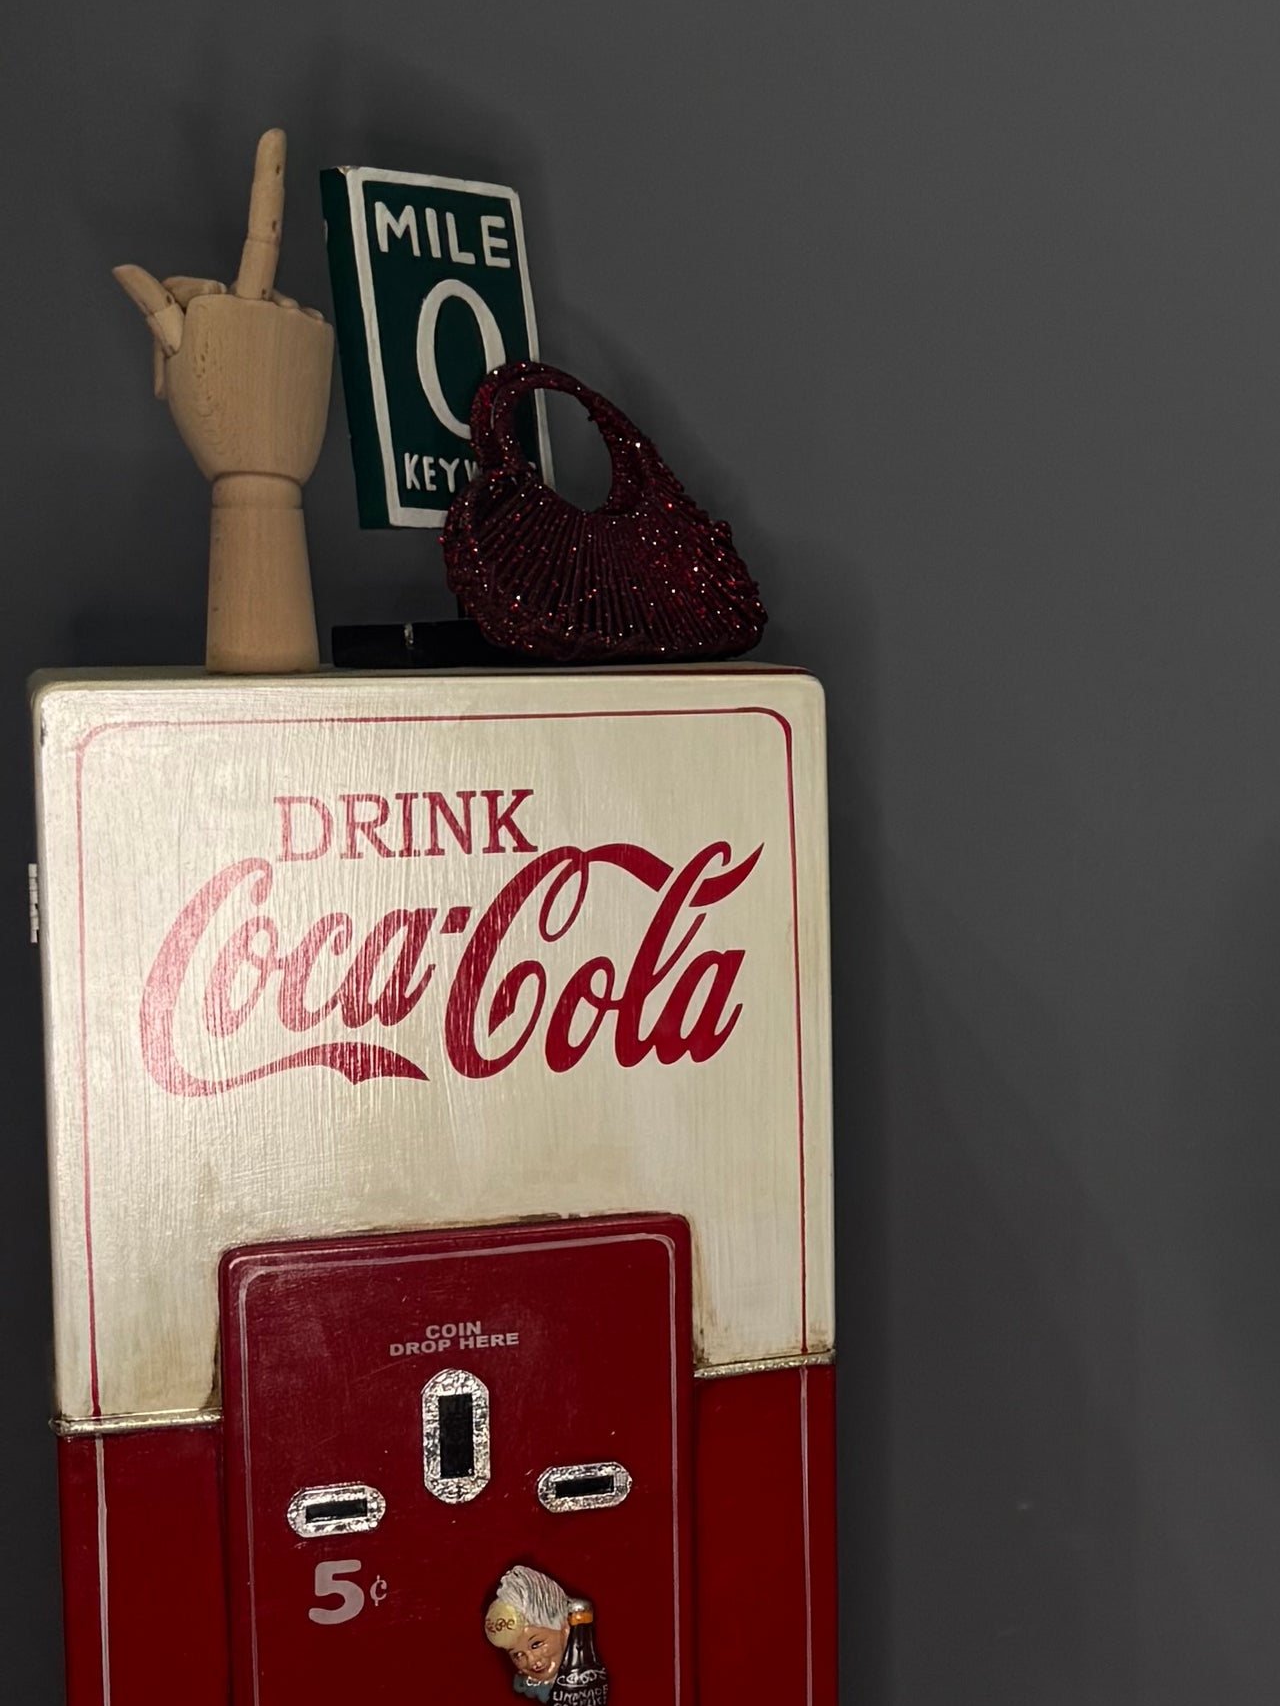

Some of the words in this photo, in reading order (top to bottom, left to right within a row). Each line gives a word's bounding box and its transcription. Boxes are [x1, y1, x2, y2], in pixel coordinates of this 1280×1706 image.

[374, 199, 512, 270] MILE
[273, 787, 540, 864] DRINK
[138, 840, 766, 1097] Coca-Cola
[389, 1338, 452, 1357] DROP
[458, 1332, 520, 1350] HERE
[425, 1320, 483, 1340] COIN
